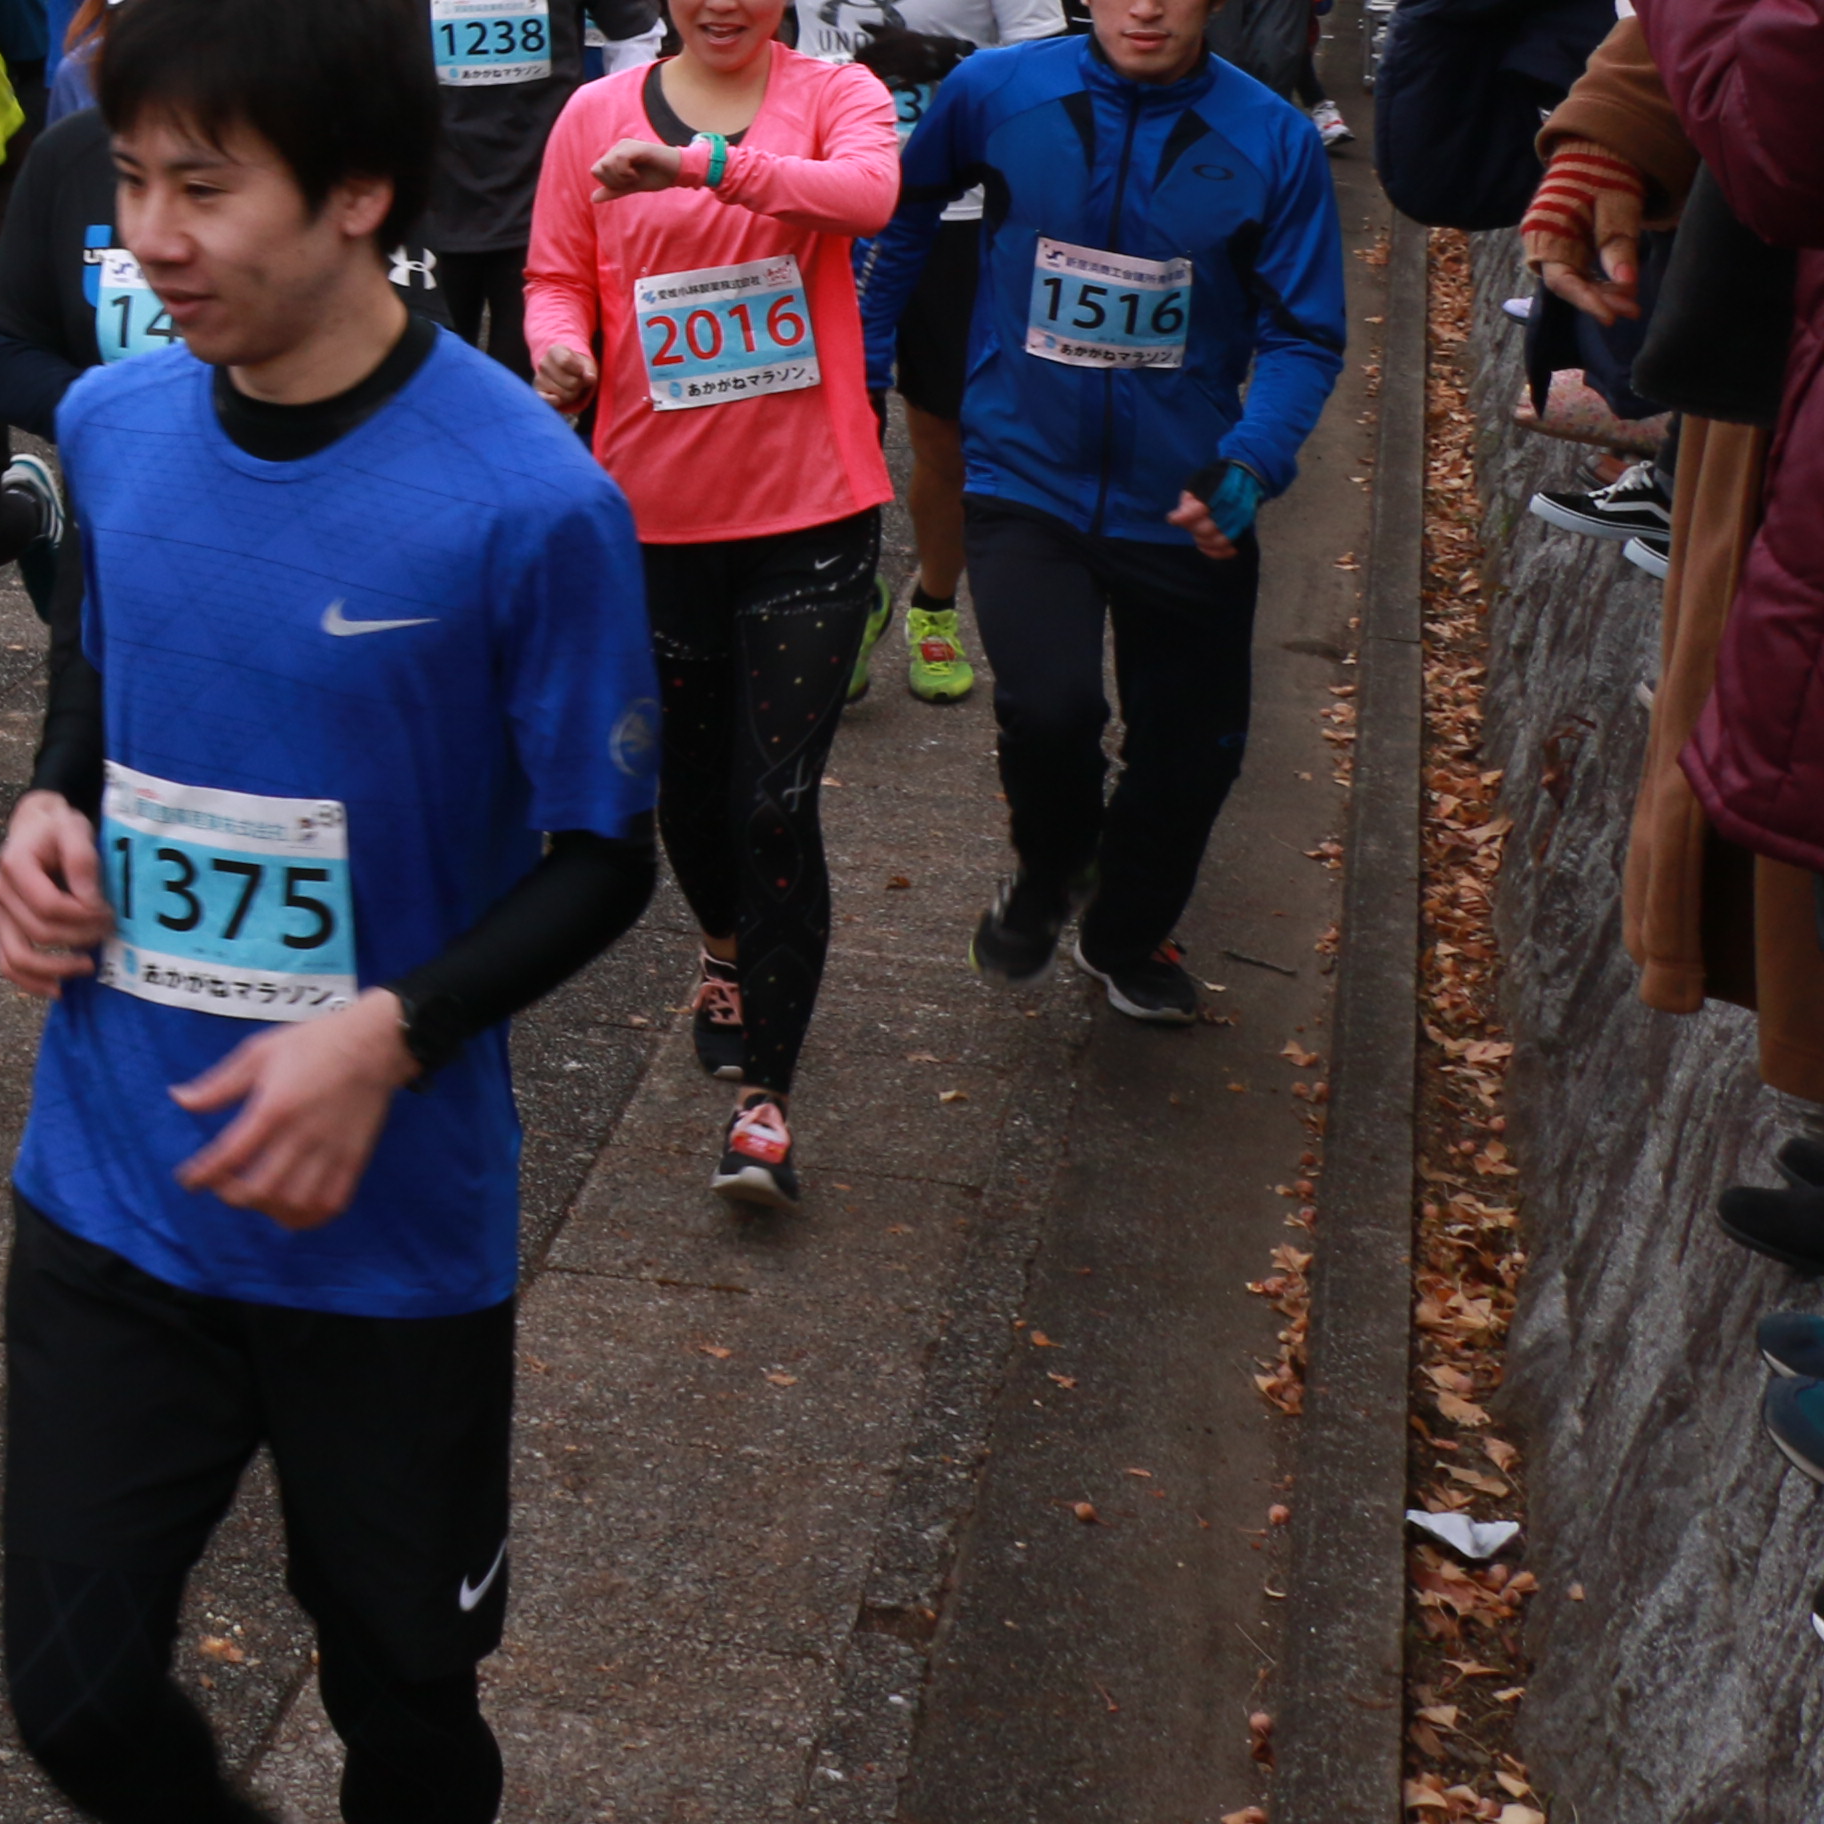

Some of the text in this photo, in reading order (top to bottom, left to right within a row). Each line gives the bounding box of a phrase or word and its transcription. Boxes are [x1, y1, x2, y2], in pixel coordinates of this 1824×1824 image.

[440, 18, 546, 56] 1238
[1043, 277, 1185, 335] 1516
[645, 294, 807, 367] 2016
[1060, 343, 1173, 362] あかがねマラソン
[687, 366, 807, 397] あかがねマラソン
[114, 836, 336, 950] 1375
[142, 963, 334, 1006] あかがねマラソン
